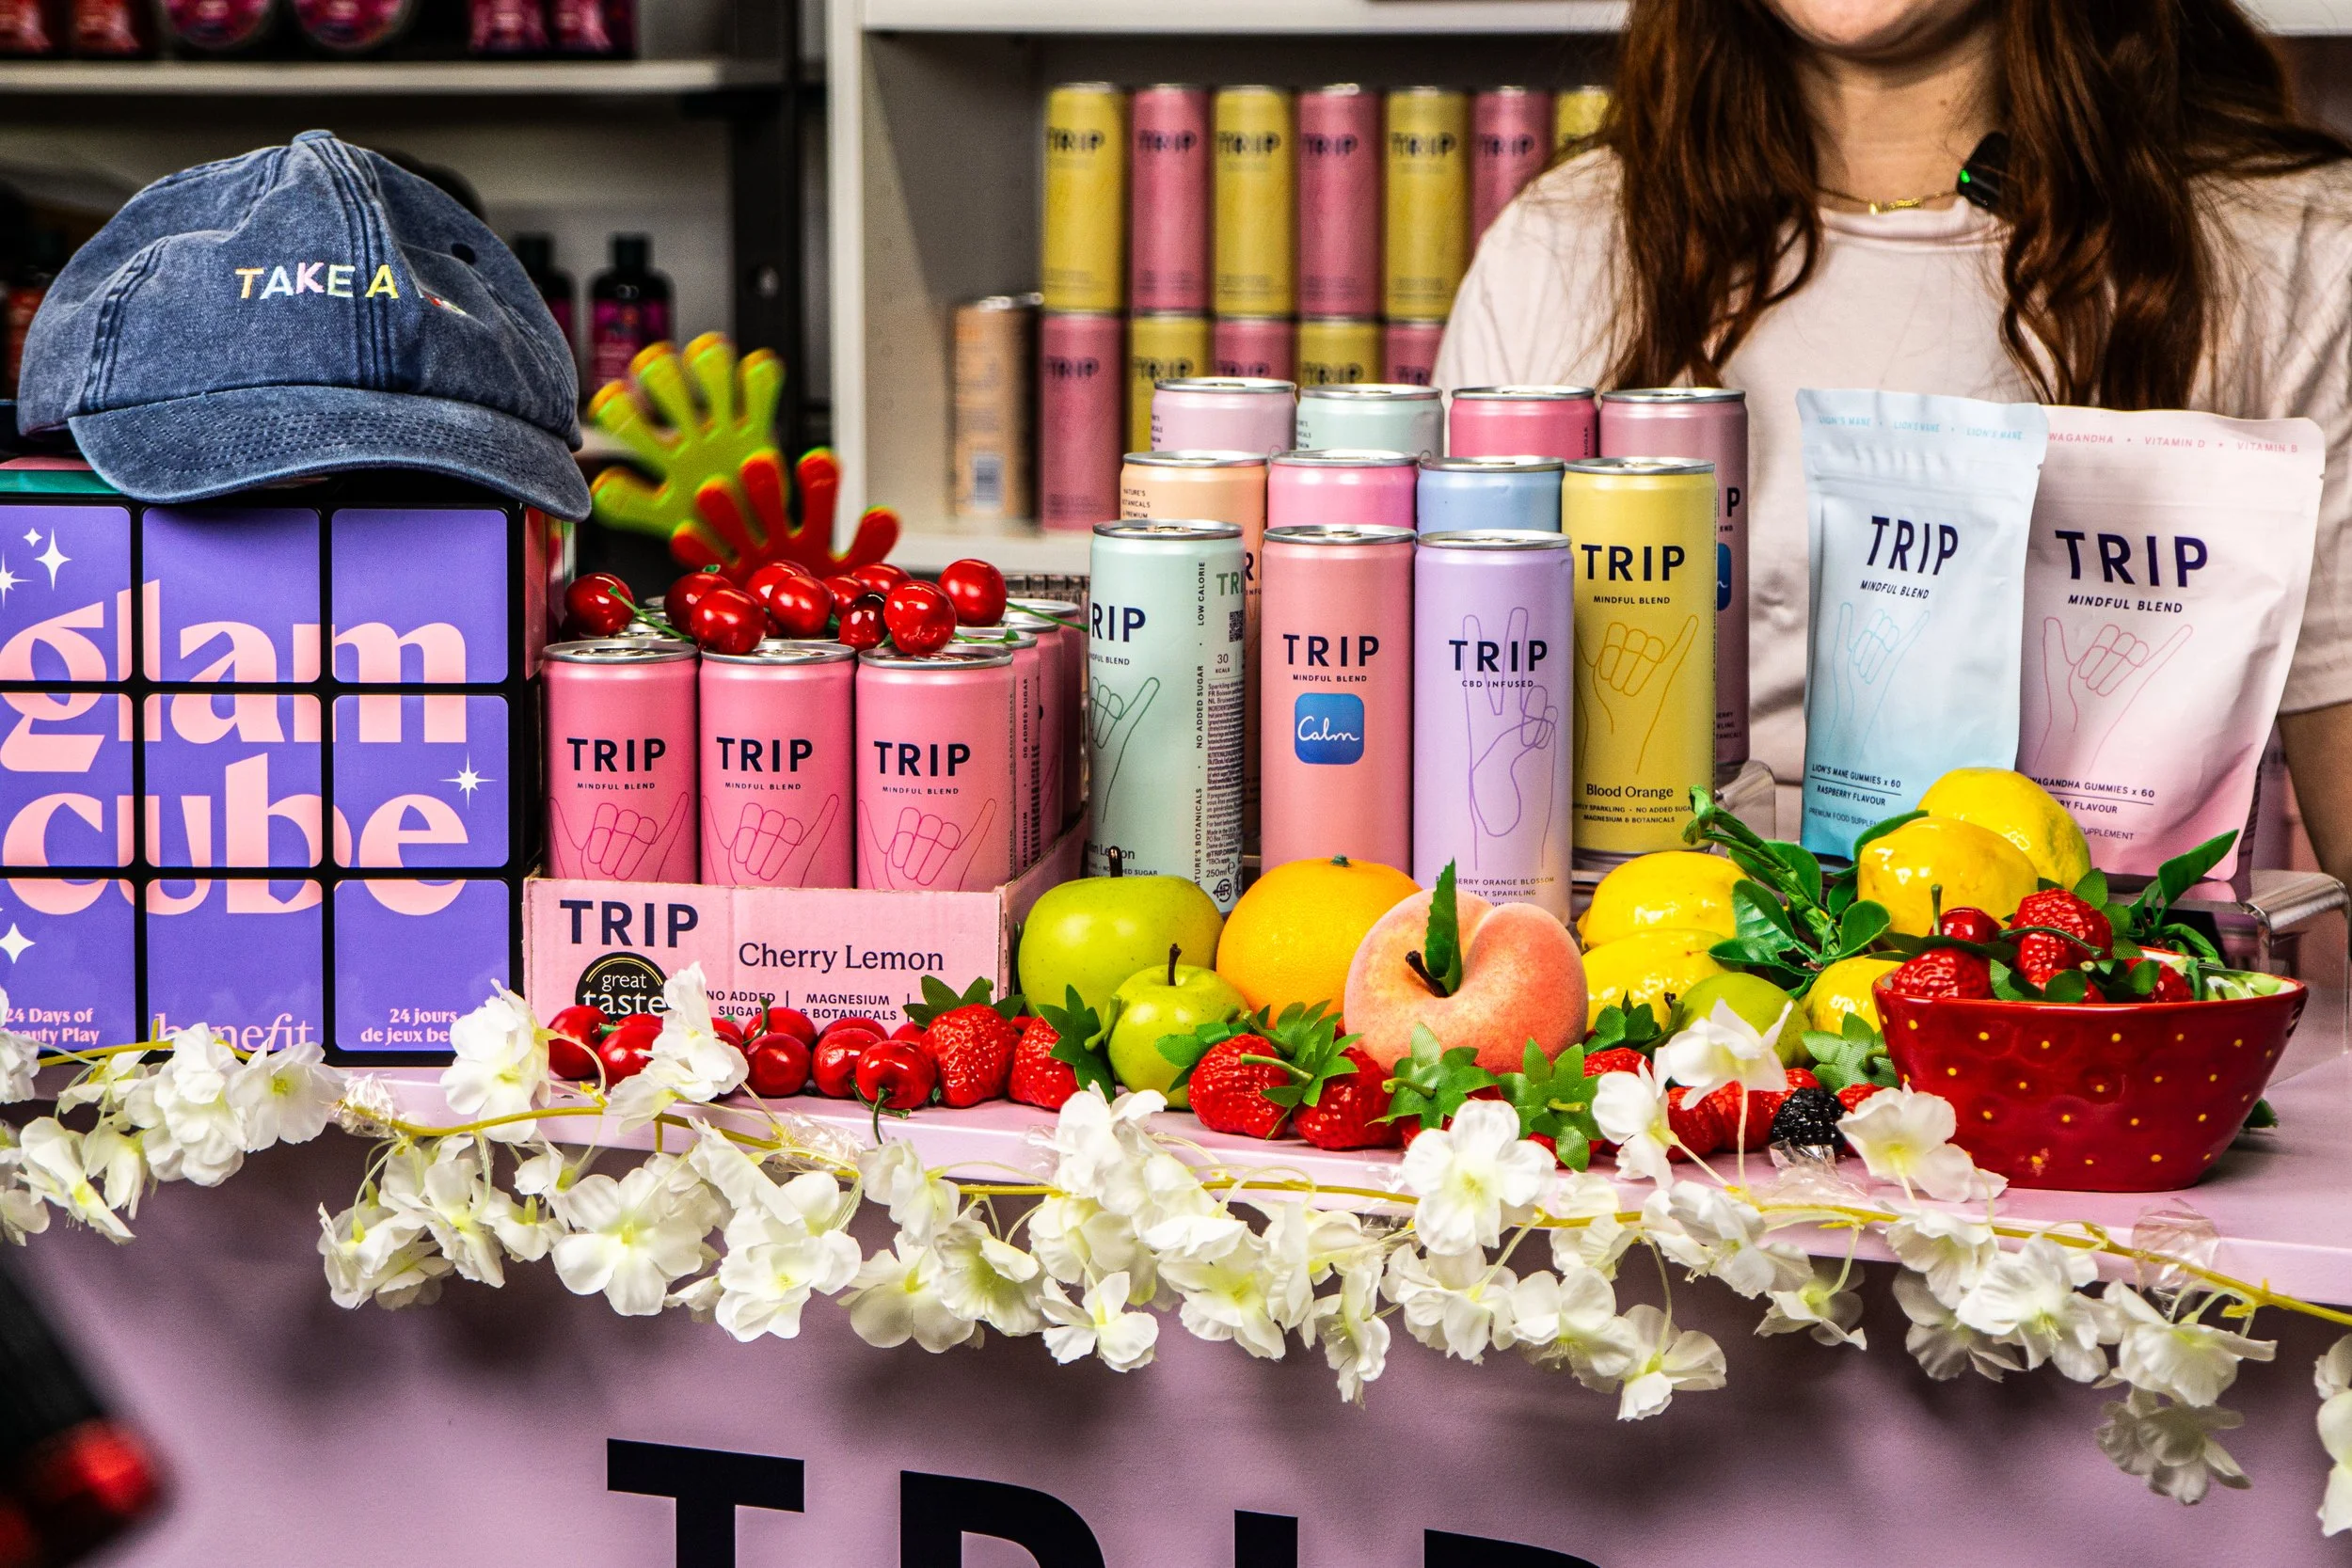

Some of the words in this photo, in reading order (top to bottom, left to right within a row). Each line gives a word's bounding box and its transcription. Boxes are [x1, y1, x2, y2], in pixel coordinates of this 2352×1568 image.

[235, 262, 356, 299] TAKE
[365, 264, 400, 299] A
[2048, 433, 2114, 444] WAGANDHA
[2145, 436, 2193, 448] VITAMIN
[2197, 439, 2206, 448] D
[2236, 441, 2286, 452] VITAMIN
[1867, 515, 1959, 576] TRIP
[1581, 544, 1685, 581] TRIP
[2055, 530, 2208, 588] TRIP
[1216, 571, 1244, 596] TRI
[1860, 579, 1898, 594] MINDFUL
[1899, 585, 1930, 599] BLEND
[1594, 594, 1635, 605] MINDFUL
[1639, 596, 1670, 605] BLEND
[2068, 594, 2130, 610] MINDFUL
[2137, 600, 2183, 613] BLEND
[1092, 602, 1146, 642] RIP
[1216, 653, 1229, 664] 30
[1283, 633, 1380, 667] TRIP
[1449, 640, 1548, 673] TRIP
[1105, 656, 1130, 666] BLEND
[0, 578, 467, 773] glam
[1293, 673, 1332, 682] MINDFUL
[1297, 715, 1360, 741] Calm
[1197, 735, 1202, 749] NO
[566, 736, 666, 772] TRIP
[716, 736, 813, 772] TRIP
[874, 740, 971, 777] TRIP
[1812, 763, 1831, 774] LION'S
[1833, 768, 1849, 779] MANE
[1850, 771, 1882, 784] GUMMIES
[1890, 779, 1901, 788] 60
[725, 782, 765, 790] MINDFUL
[882, 786, 923, 795] MINDFUL
[1586, 784, 1621, 798] Blood
[1625, 786, 1674, 800] Orange
[1817, 784, 1851, 800] RASPBERRY
[1852, 792, 1886, 806] FLAVOUR
[2085, 782, 2128, 795] GUMMIES
[2141, 788, 2155, 798] 60
[1589, 804, 1626, 813] SPARKLING
[2074, 801, 2118, 814] FLAVOUR
[1583, 814, 1623, 823] MAGNESIUM
[3, 752, 469, 915] cube
[1100, 843, 1136, 860] Leon
[1520, 877, 1555, 885] BLOSSOM
[1492, 889, 1536, 897] SPARKLING
[560, 899, 699, 948] TRIP
[739, 942, 838, 974] Cherry
[846, 944, 945, 971] Lemon
[601, 974, 647, 992] great
[582, 989, 665, 1017] taste
[706, 990, 725, 1001] NO
[730, 991, 776, 1003] ADDED
[805, 993, 890, 1006] MAGNESIUM
[6, 1007, 25, 1023] 24
[29, 1008, 71, 1026] Days
[74, 1007, 93, 1023] of
[389, 1008, 410, 1023] 24
[411, 1008, 458, 1027] jours
[813, 1008, 898, 1021] BOTANICALS
[62, 1027, 101, 1046] Play
[154, 1013, 314, 1052] bnefit
[360, 1027, 383, 1043] de
[384, 1027, 422, 1046] jeux
